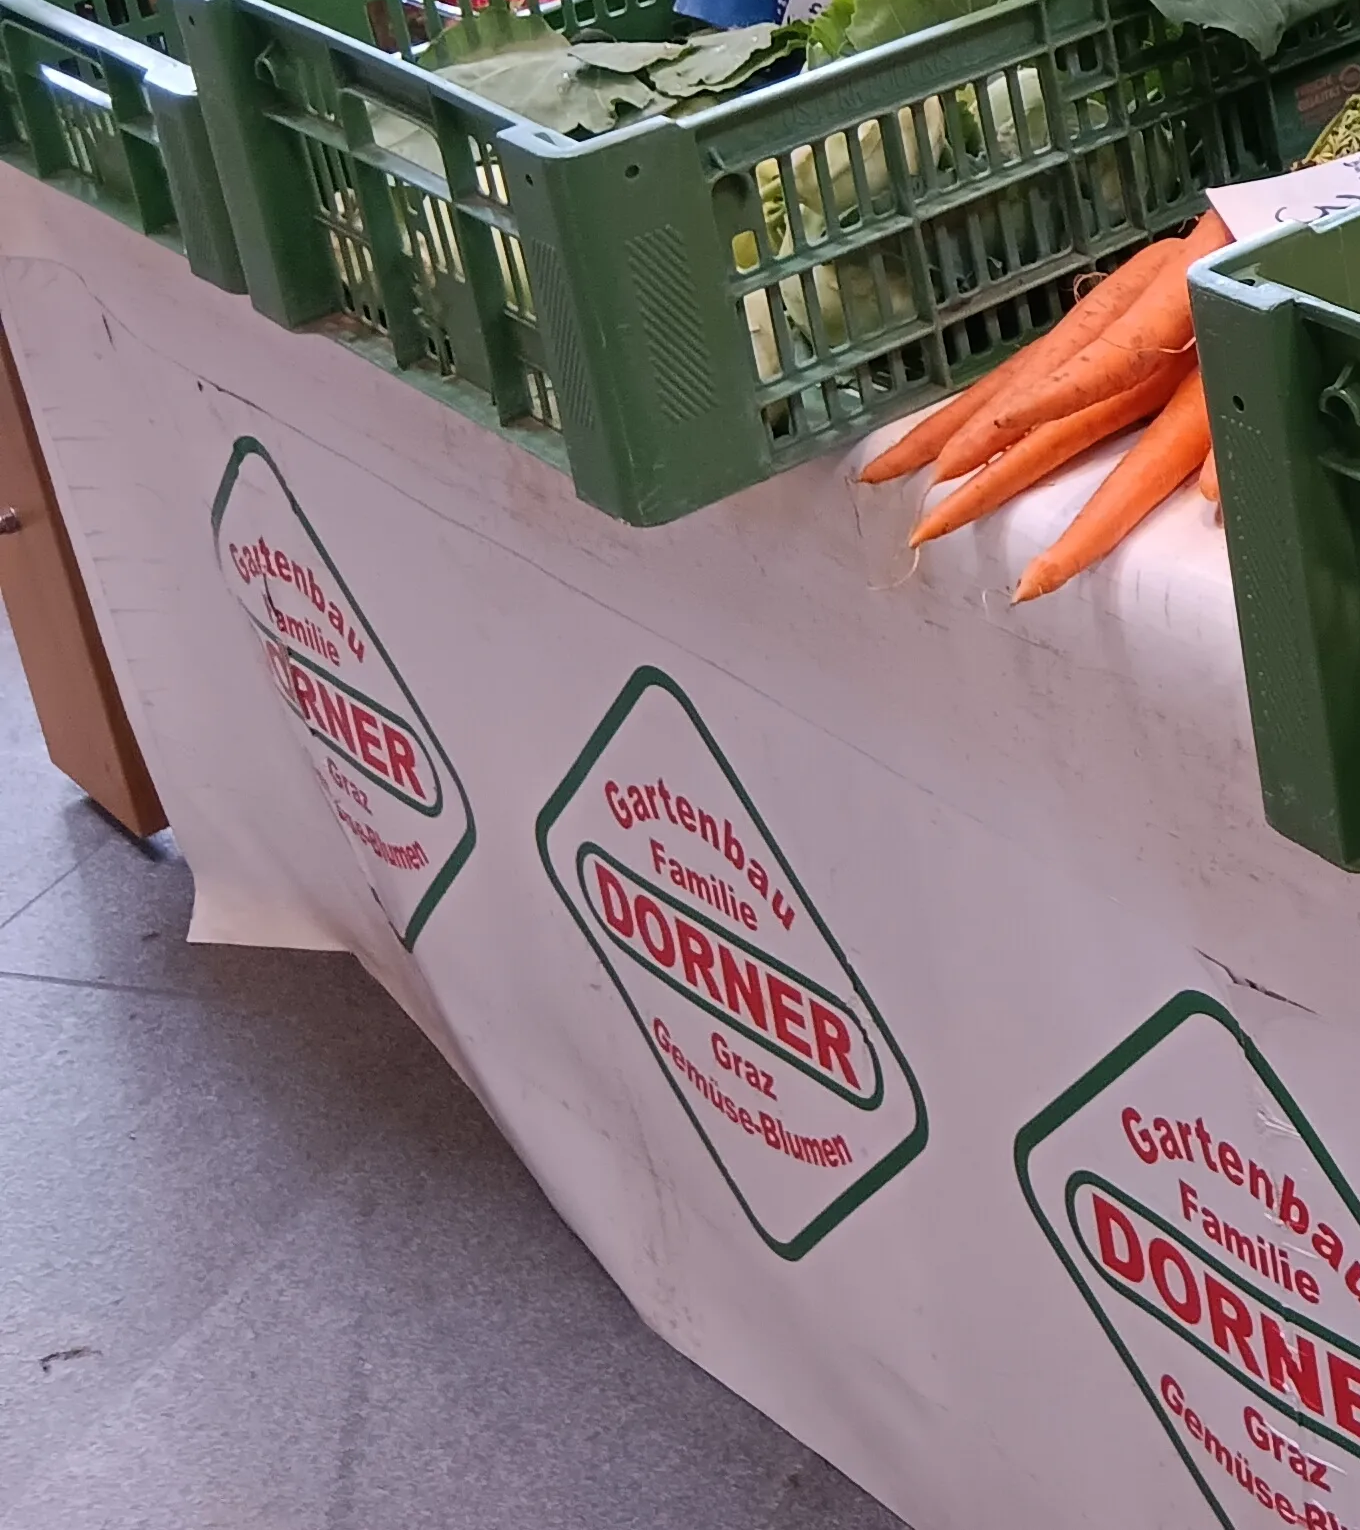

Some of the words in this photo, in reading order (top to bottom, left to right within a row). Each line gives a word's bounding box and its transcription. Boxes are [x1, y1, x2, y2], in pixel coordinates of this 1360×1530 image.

[229, 535, 366, 664] Gartenbau
[264, 638, 427, 801] ORNER
[604, 777, 796, 932] Gartenbau
[648, 837, 759, 932] Familie
[594, 859, 862, 1092] DORNER
[652, 1016, 854, 1169] Gemüse-Blumen
[709, 1031, 779, 1101] Graz
[1178, 1178, 1321, 1305] Familie
[1160, 1373, 1349, 1530] Gemüse-Bl
[1243, 1405, 1332, 1494] Graz
